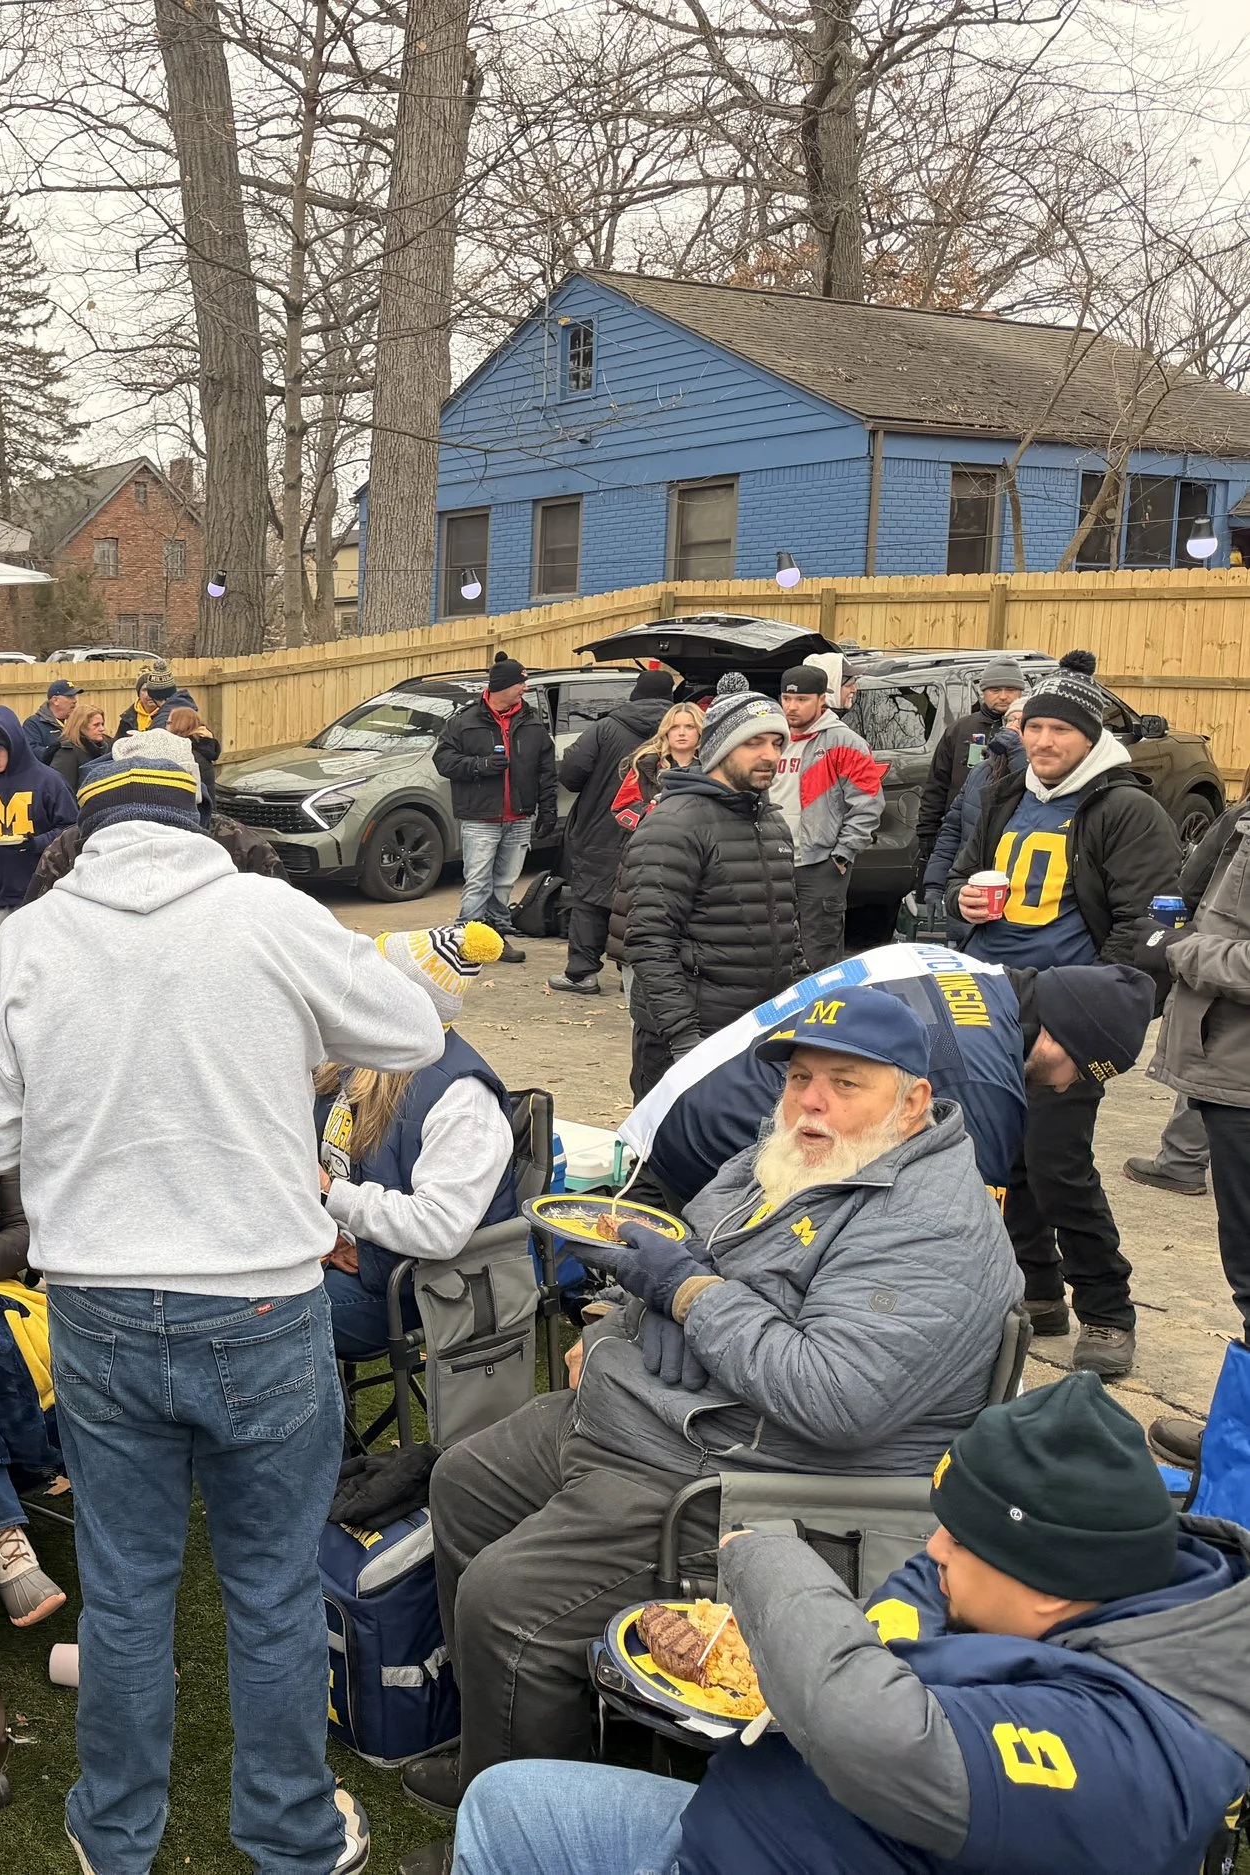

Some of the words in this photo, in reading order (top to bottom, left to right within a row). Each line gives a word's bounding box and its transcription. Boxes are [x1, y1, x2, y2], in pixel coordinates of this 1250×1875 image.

[995, 831, 1069, 926] 10
[804, 1000, 846, 1025] M
[790, 1215, 818, 1247] M
